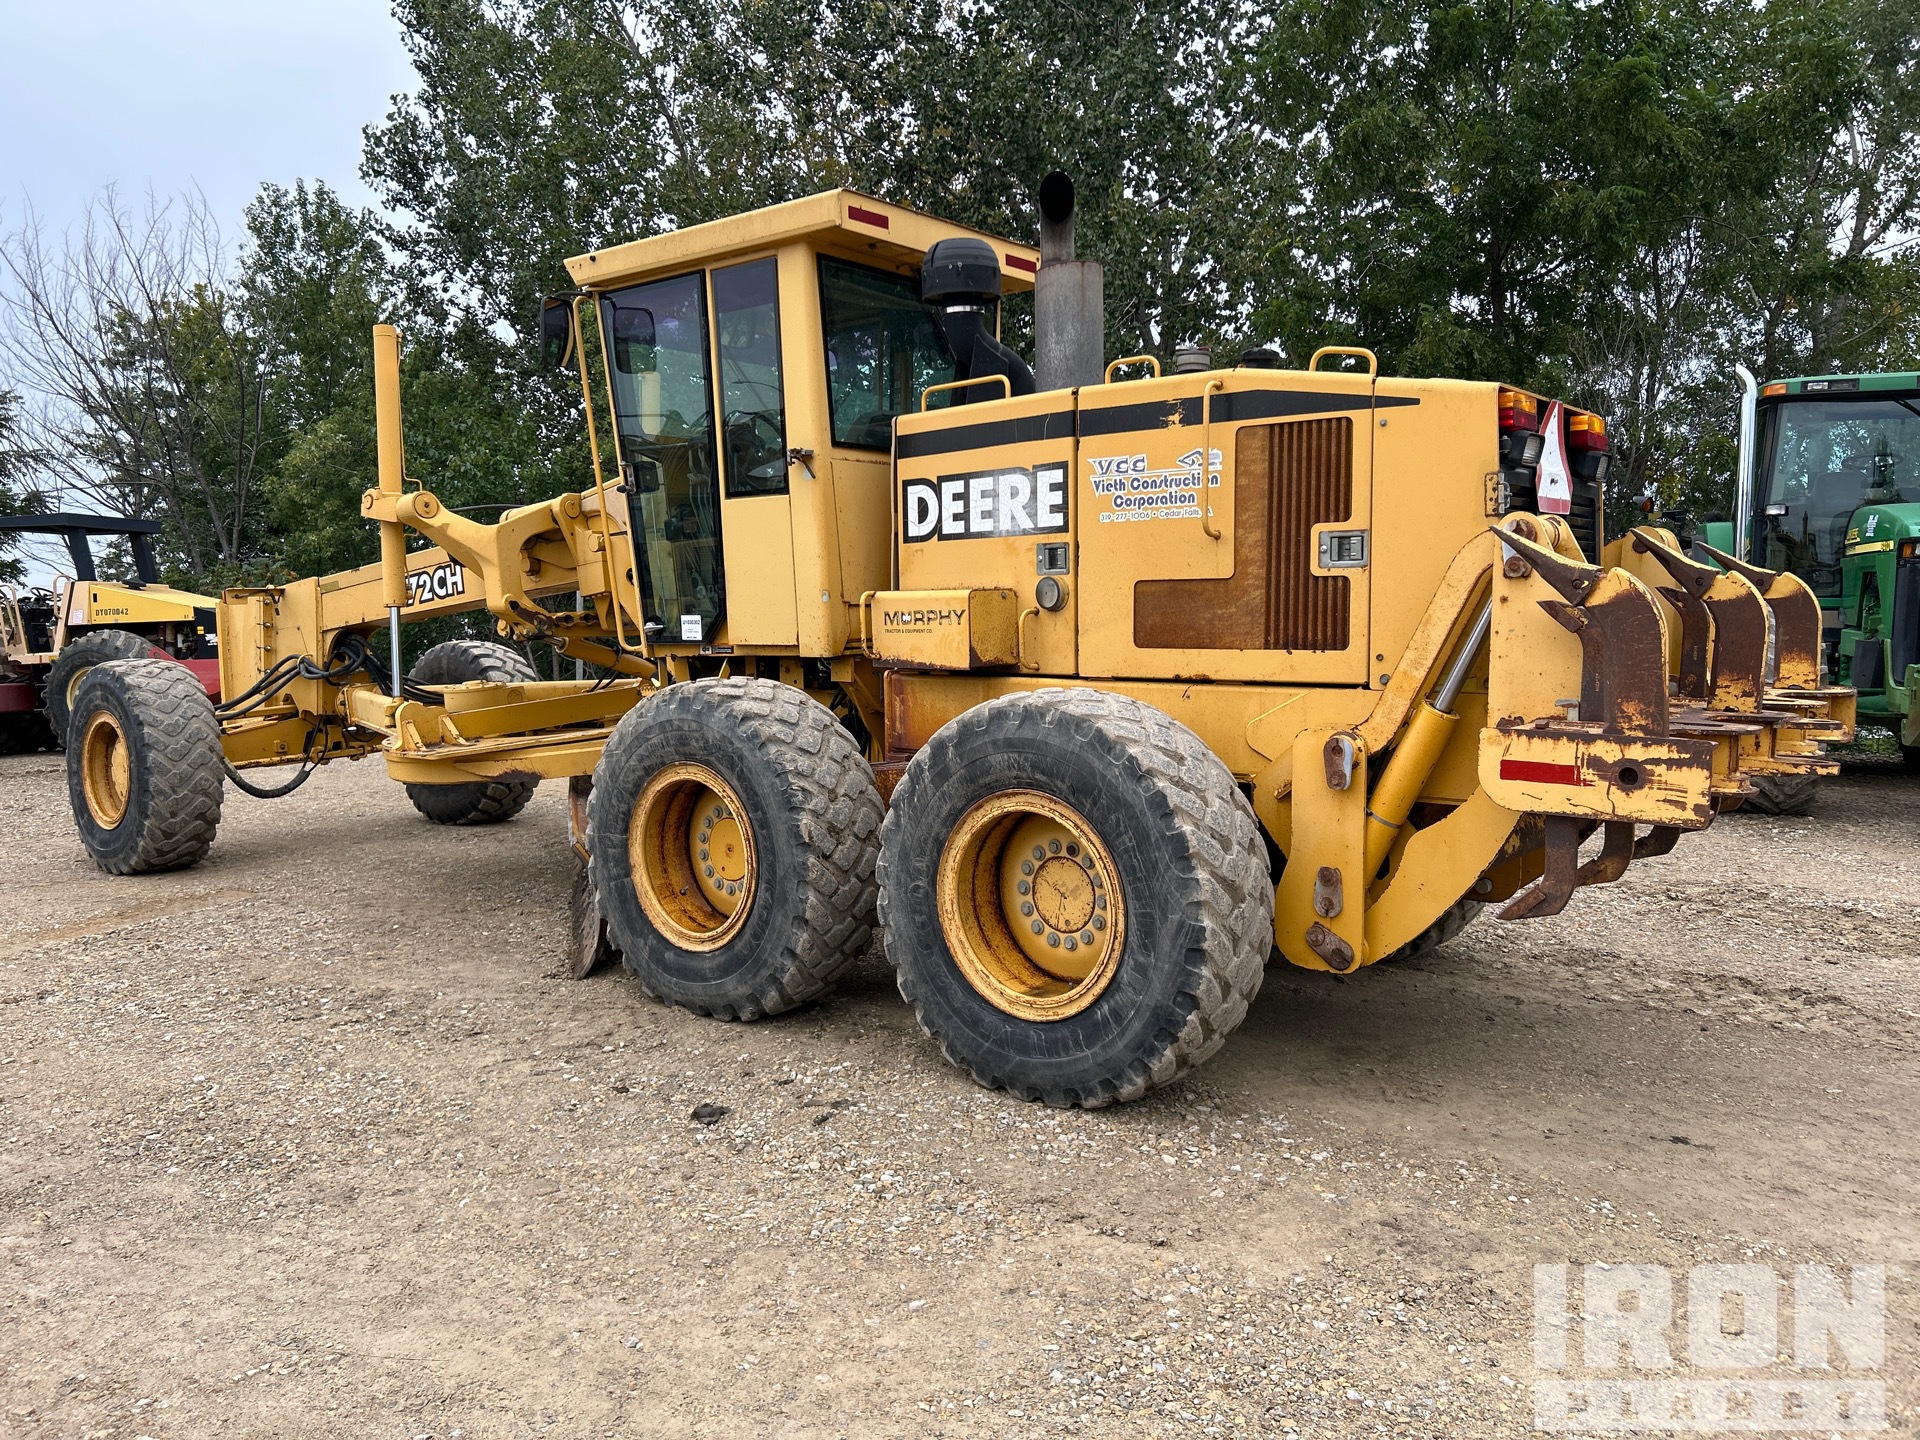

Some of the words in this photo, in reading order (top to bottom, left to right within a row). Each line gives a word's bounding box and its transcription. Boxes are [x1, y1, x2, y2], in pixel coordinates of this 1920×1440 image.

[1092, 455, 1146, 475] VCC
[1093, 478, 1126, 493] Vieth
[1130, 472, 1219, 491] Constructin
[907, 468, 1064, 537] DEERE
[1113, 491, 1196, 510] Corporation
[1100, 512, 1150, 522] 319-277-1006
[884, 609, 967, 626] MURPHY
